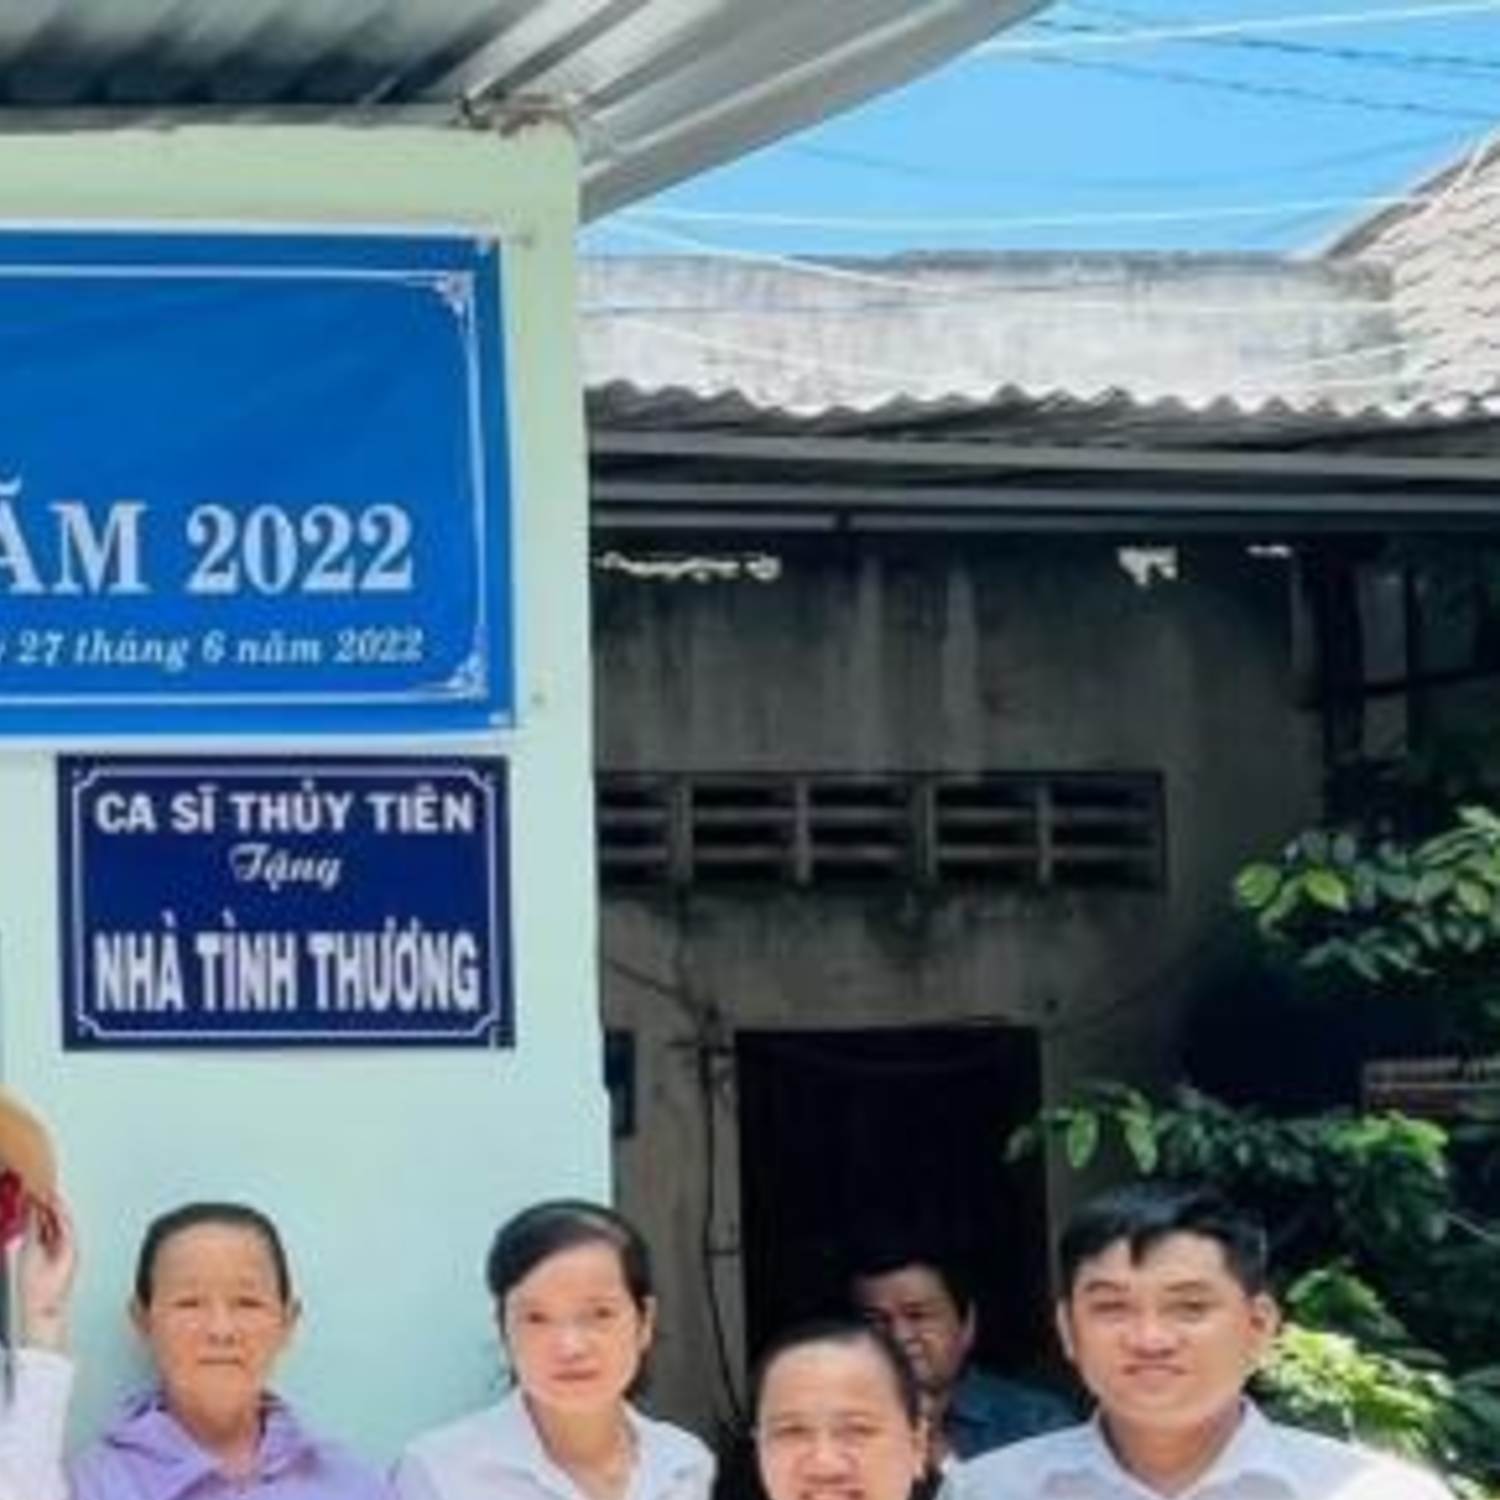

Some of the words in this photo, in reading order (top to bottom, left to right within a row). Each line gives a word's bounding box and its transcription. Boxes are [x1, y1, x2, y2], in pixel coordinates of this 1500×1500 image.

[186, 503, 414, 595] 2022
[18, 630, 63, 666] 27
[74, 628, 189, 673] tháng
[202, 629, 227, 663] 6
[237, 629, 322, 664] năm
[333, 627, 425, 664] 2022
[96, 792, 157, 834] CA
[171, 785, 220, 834] SĨ
[230, 778, 354, 834] THỦY
[366, 785, 475, 834] TIÊN
[228, 842, 344, 892] Tặng
[94, 909, 184, 1012] NHÀ
[196, 907, 297, 1012] TÌNH
[308, 917, 481, 1012] THƯƠNG
